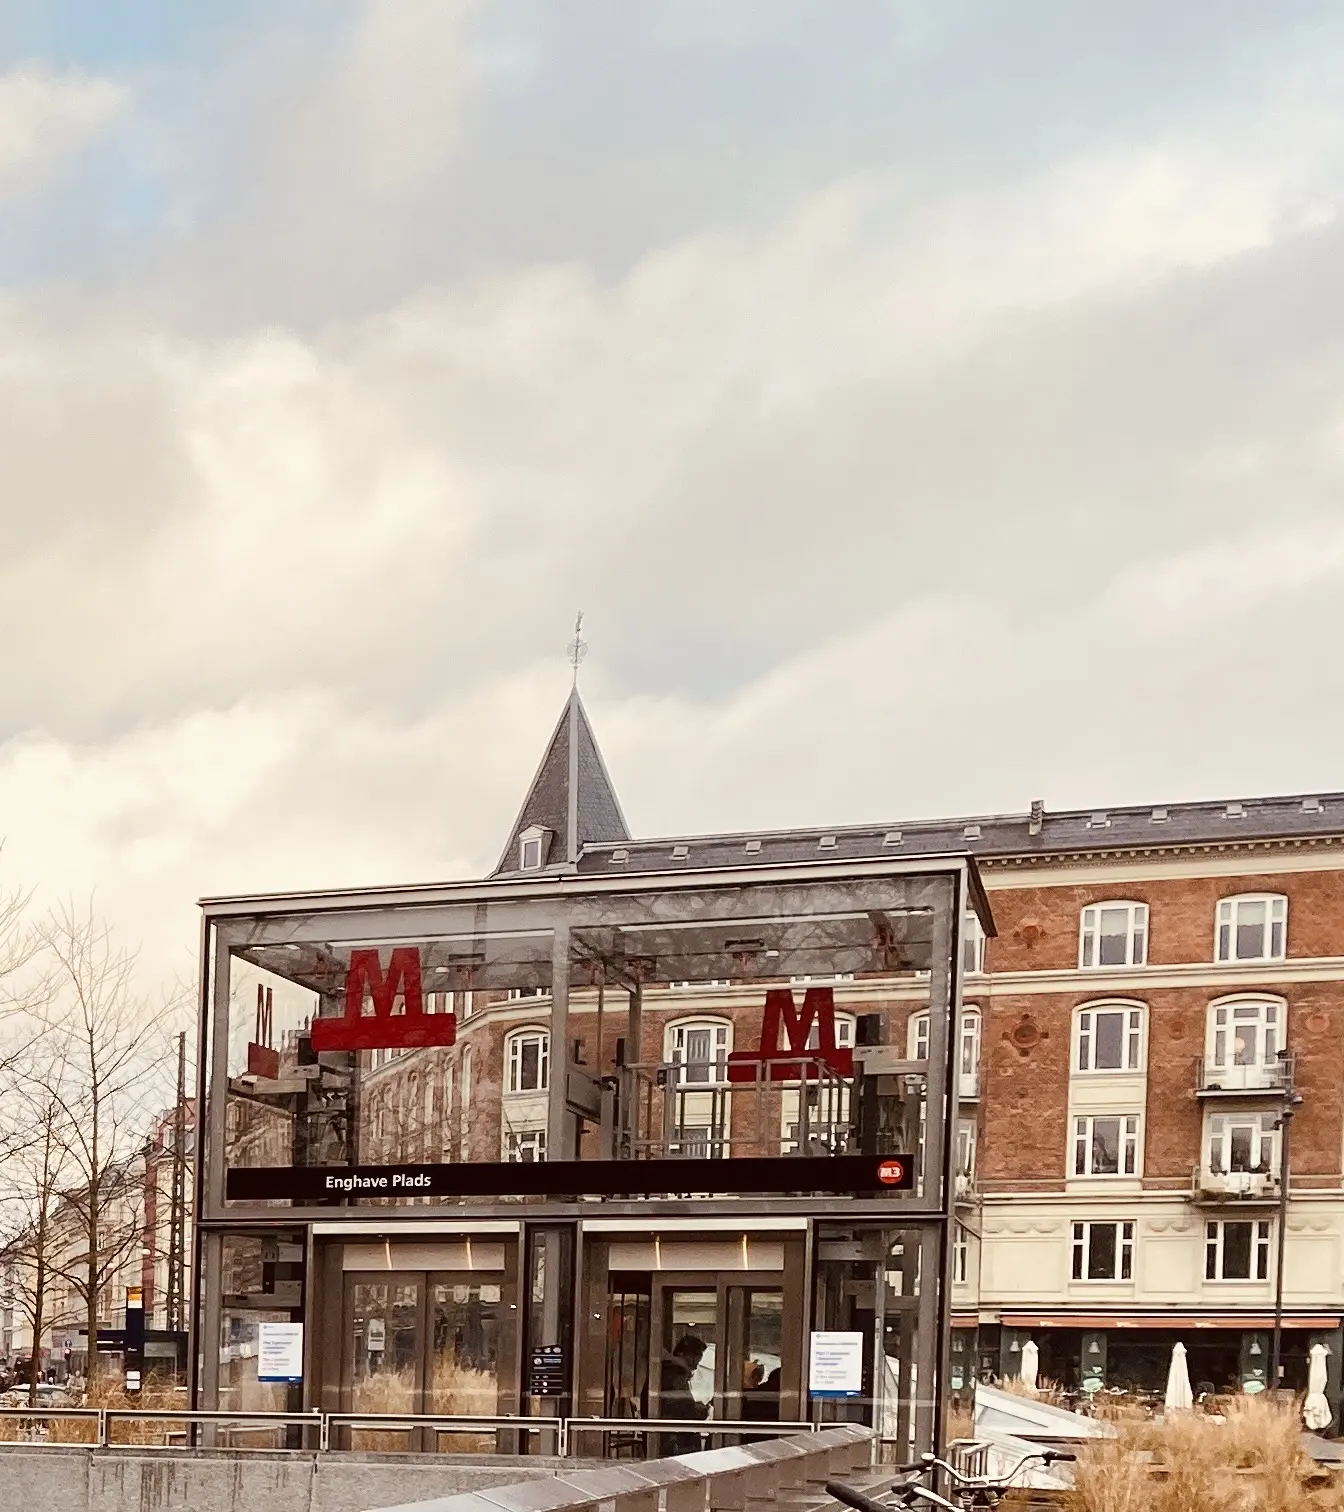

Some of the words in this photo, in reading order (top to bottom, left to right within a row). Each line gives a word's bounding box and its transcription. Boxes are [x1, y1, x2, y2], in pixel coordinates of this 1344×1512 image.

[880, 1166, 901, 1178] M3
[326, 1175, 388, 1191] Enghave
[392, 1174, 432, 1187] Plads
